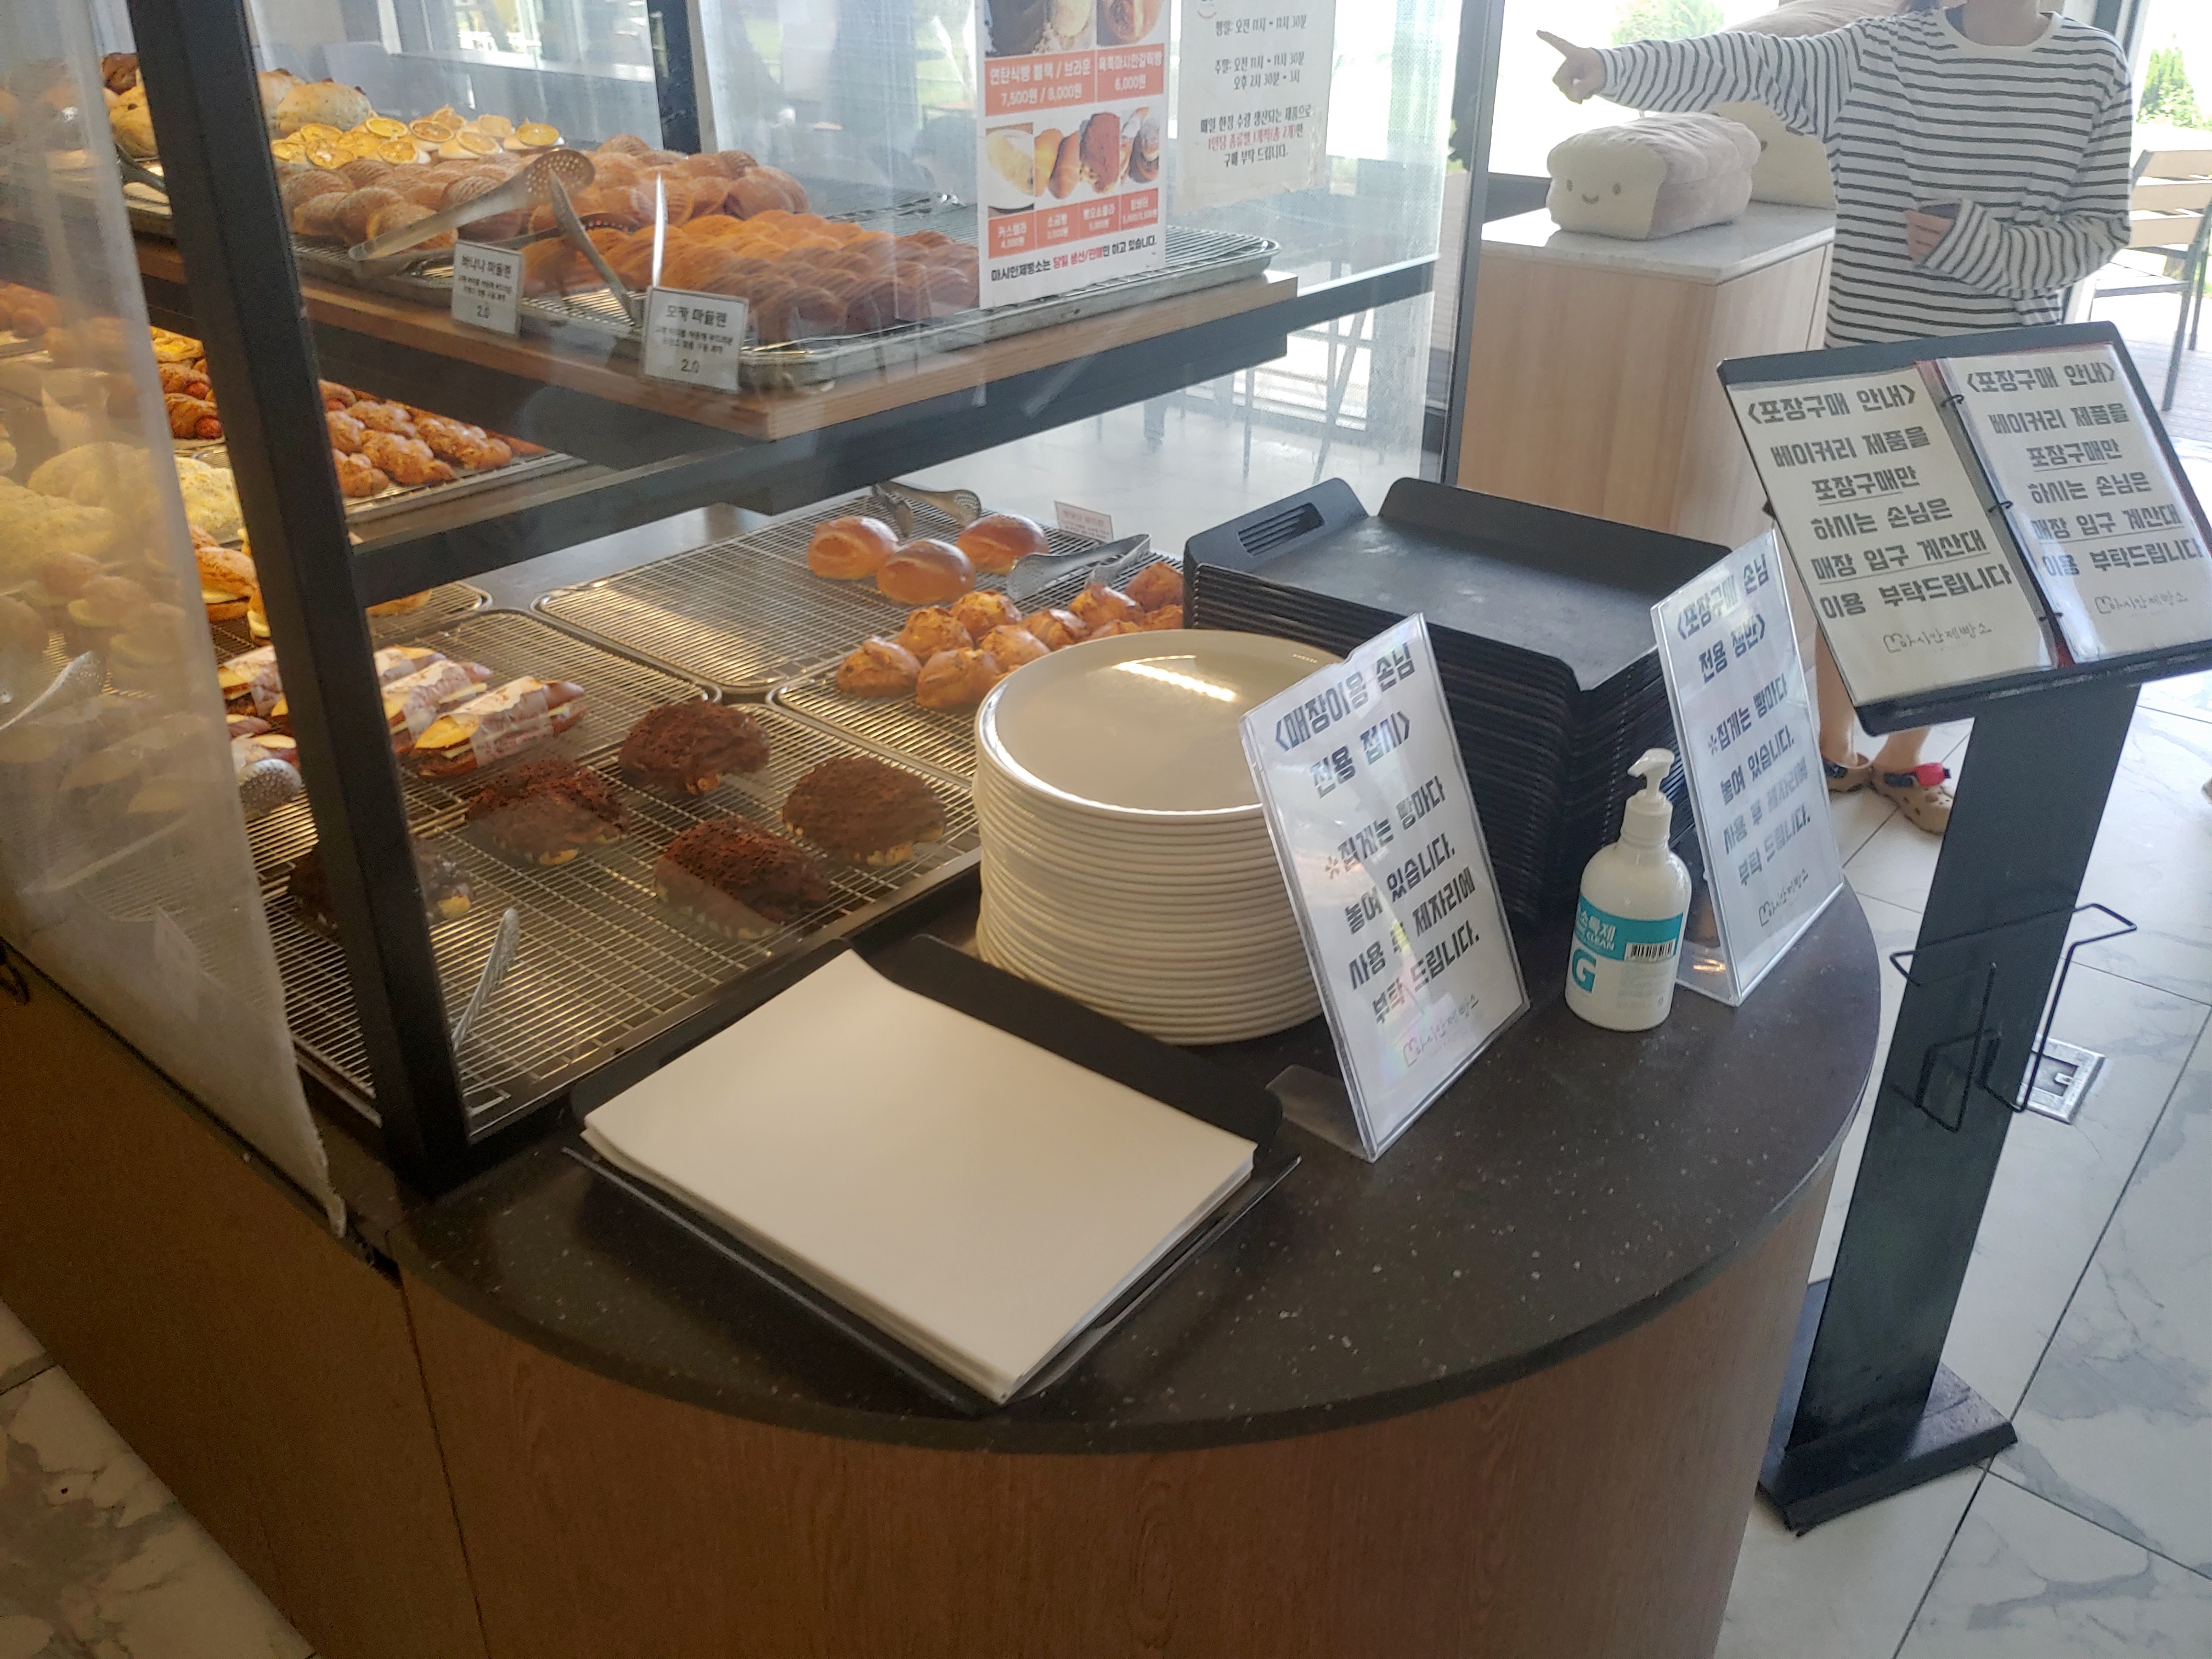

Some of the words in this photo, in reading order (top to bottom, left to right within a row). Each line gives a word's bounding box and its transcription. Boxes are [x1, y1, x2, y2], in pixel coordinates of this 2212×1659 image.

[1235, 18, 1250, 34] 오전
[1253, 18, 1266, 32] 11시
[1277, 15, 1289, 30] 11시
[1292, 14, 1307, 29] 30분
[989, 65, 1030, 85] 연탄식빵
[1064, 58, 1091, 76] 브라운
[1234, 56, 1248, 72] 오전
[1251, 55, 1263, 69] 11시
[1274, 53, 1287, 66] 11시
[1290, 51, 1305, 66] 30분
[1234, 75, 1247, 90] 오후
[1250, 74, 1261, 87] 2시
[1263, 72, 1280, 86] 30분
[1290, 70, 1300, 83] 3시
[1001, 88, 1037, 106] 7,500원
[1048, 83, 1082, 101] 8,000원
[1114, 74, 1147, 92] 6,000원
[1200, 117, 1216, 133] 매일
[1218, 115, 1234, 132] 한정
[1237, 112, 1251, 129] 수량
[1254, 108, 1282, 127] 생산되는
[1208, 134, 1227, 152] 1인당
[1229, 131, 1251, 150] 종류별
[1224, 151, 1239, 168] 구매
[1241, 149, 1255, 165] 부탁
[1257, 144, 1289, 162] 드립니다.
[991, 258, 1052, 281] 마시안제빵소는
[1053, 254, 1069, 269] 당일
[1112, 241, 1126, 255] 하고
[1128, 234, 1157, 251] 있습니다.
[692, 308, 727, 328] 마들렌
[1966, 366, 2059, 393] <포장구매
[2063, 362, 2115, 386] 안내>
[1748, 392, 1850, 425] <포장구매
[1857, 384, 1916, 412] 안내>
[1988, 409, 2068, 435] 베이커리
[2069, 403, 2130, 427] 제품을
[1770, 437, 1858, 467] 베이커리
[1861, 426, 1931, 456] 제품을
[2025, 438, 2123, 467] 포장구매만
[1812, 466, 1921, 501] 포장구매만
[2028, 479, 2089, 504] 하시는
[2096, 471, 2153, 497] 손님은
[1810, 512, 1879, 540] 하시는
[1887, 498, 1953, 529] 손님은
[2030, 517, 2071, 540] 매장
[2076, 511, 2117, 536] 입구
[2121, 503, 2182, 531] 계산대
[1743, 554, 1769, 595] 손님
[1810, 553, 1857, 580] 매장
[1863, 544, 1910, 572] 입구
[1915, 529, 1988, 561] 계산대
[2042, 554, 2081, 577] 이용
[2089, 538, 2204, 572] 부탁드립니다
[1819, 592, 1867, 619] 이용
[1878, 563, 2013, 608] 부탁드립니다
[1699, 639, 1728, 685] 전용
[1274, 670, 1369, 752] <매장이용
[1376, 641, 1416, 693] 손님
[1753, 672, 1787, 719] 빵마다
[1309, 745, 1356, 799] 전용
[1720, 764, 1746, 806] 놓여
[1747, 724, 1795, 782] 있습니다.
[1396, 775, 1447, 831] 빵마다
[1723, 814, 1748, 855] 사용
[1750, 798, 1763, 826] 후
[1766, 755, 1808, 813] 제자리에
[1738, 848, 1763, 886] 부탁
[1763, 803, 1811, 863] 드립니다.
[1345, 885, 1384, 935] 놓여
[1386, 832, 1455, 904] 있습니다.
[1348, 940, 1386, 991] 사용
[1412, 865, 1475, 938] 제자리에
[1576, 904, 1616, 942] 소독제
[1586, 931, 1615, 951] CLEAN
[1372, 977, 1406, 1025] 부탁
[1409, 919, 1480, 993] 드립니다.
[1572, 949, 1597, 994] G
